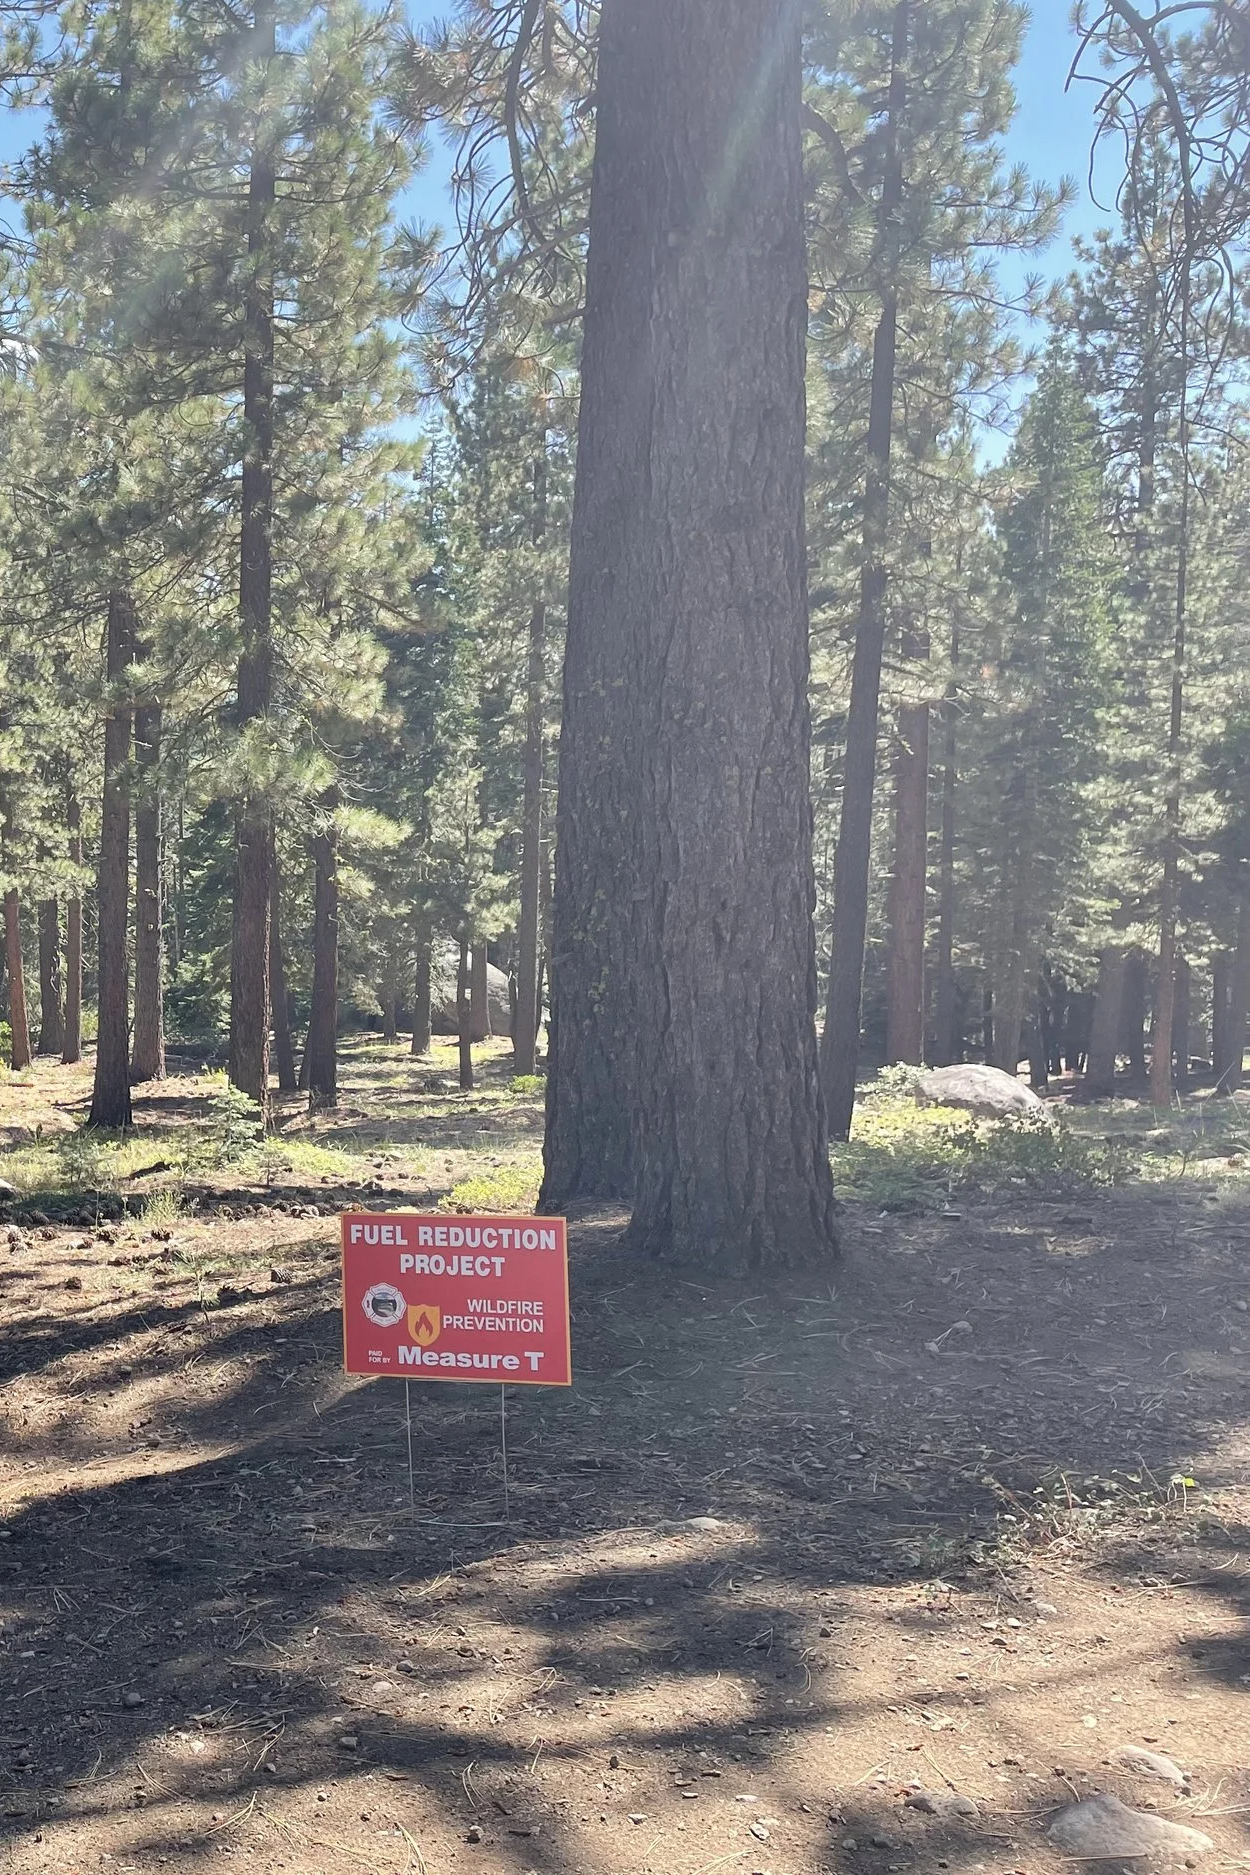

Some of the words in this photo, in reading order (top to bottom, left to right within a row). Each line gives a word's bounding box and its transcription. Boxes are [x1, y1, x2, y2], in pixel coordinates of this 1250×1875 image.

[350, 1225, 408, 1246] FUEL
[418, 1226, 556, 1250] REDUCTION
[400, 1254, 506, 1277] PROJECT
[467, 1299, 544, 1315] WILDFIRE
[443, 1315, 544, 1333] PREVENTION
[398, 1346, 520, 1370] Measure
[524, 1351, 545, 1371] T
